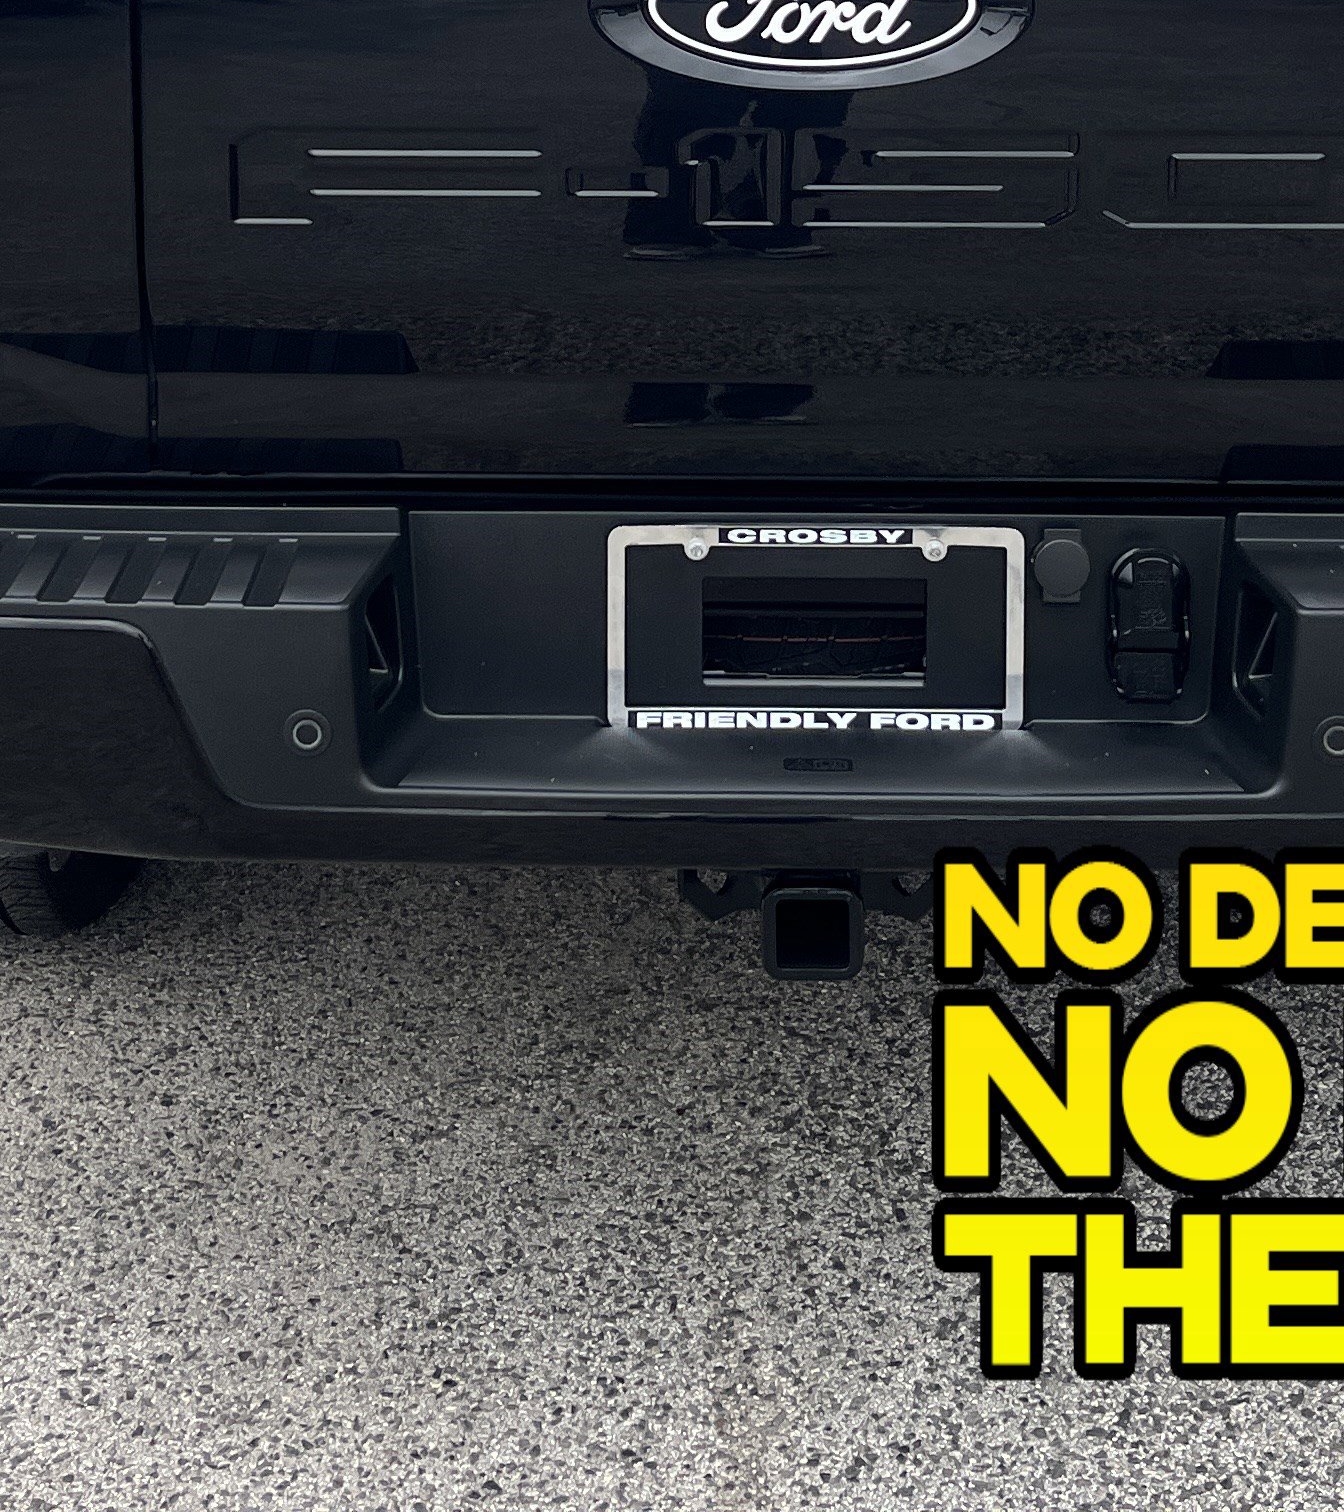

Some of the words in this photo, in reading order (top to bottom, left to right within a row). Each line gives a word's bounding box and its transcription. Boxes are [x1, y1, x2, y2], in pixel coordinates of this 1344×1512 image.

[726, 528, 906, 544] CROSBY
[636, 711, 857, 730] FRIENDLY
[870, 713, 996, 731] FORD
